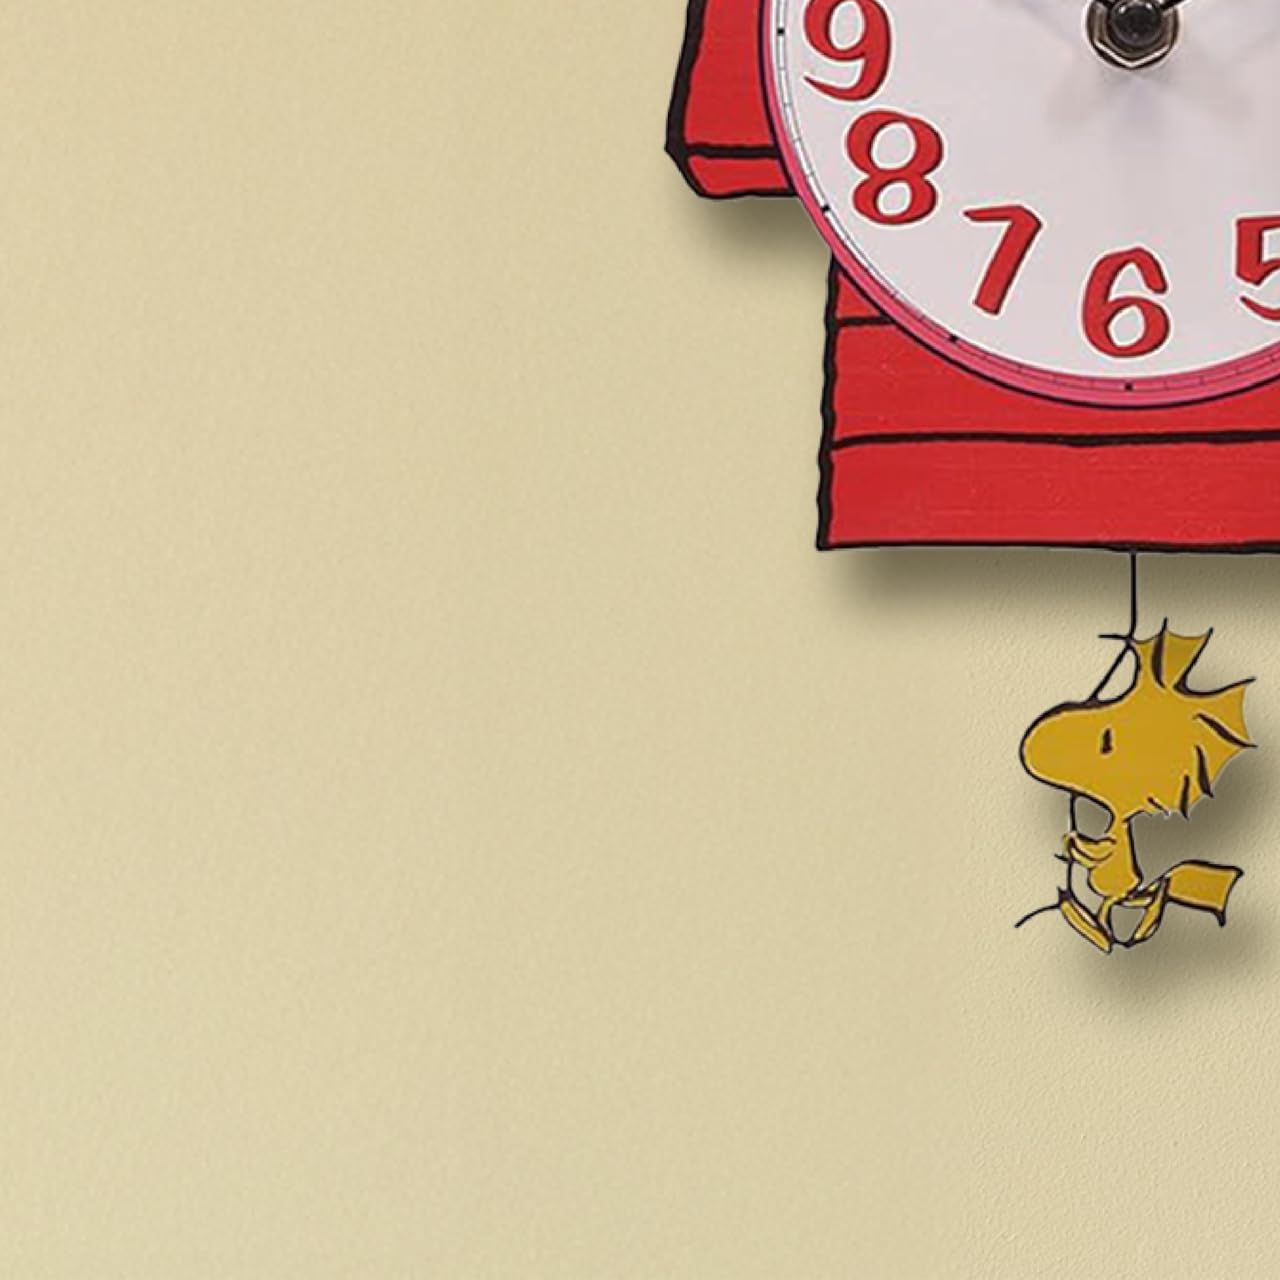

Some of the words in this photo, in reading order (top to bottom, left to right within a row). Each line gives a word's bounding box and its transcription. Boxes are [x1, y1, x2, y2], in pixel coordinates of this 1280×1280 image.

[845, 109, 943, 226] 8
[964, 203, 1042, 315] 7
[1081, 245, 1170, 359] 6
